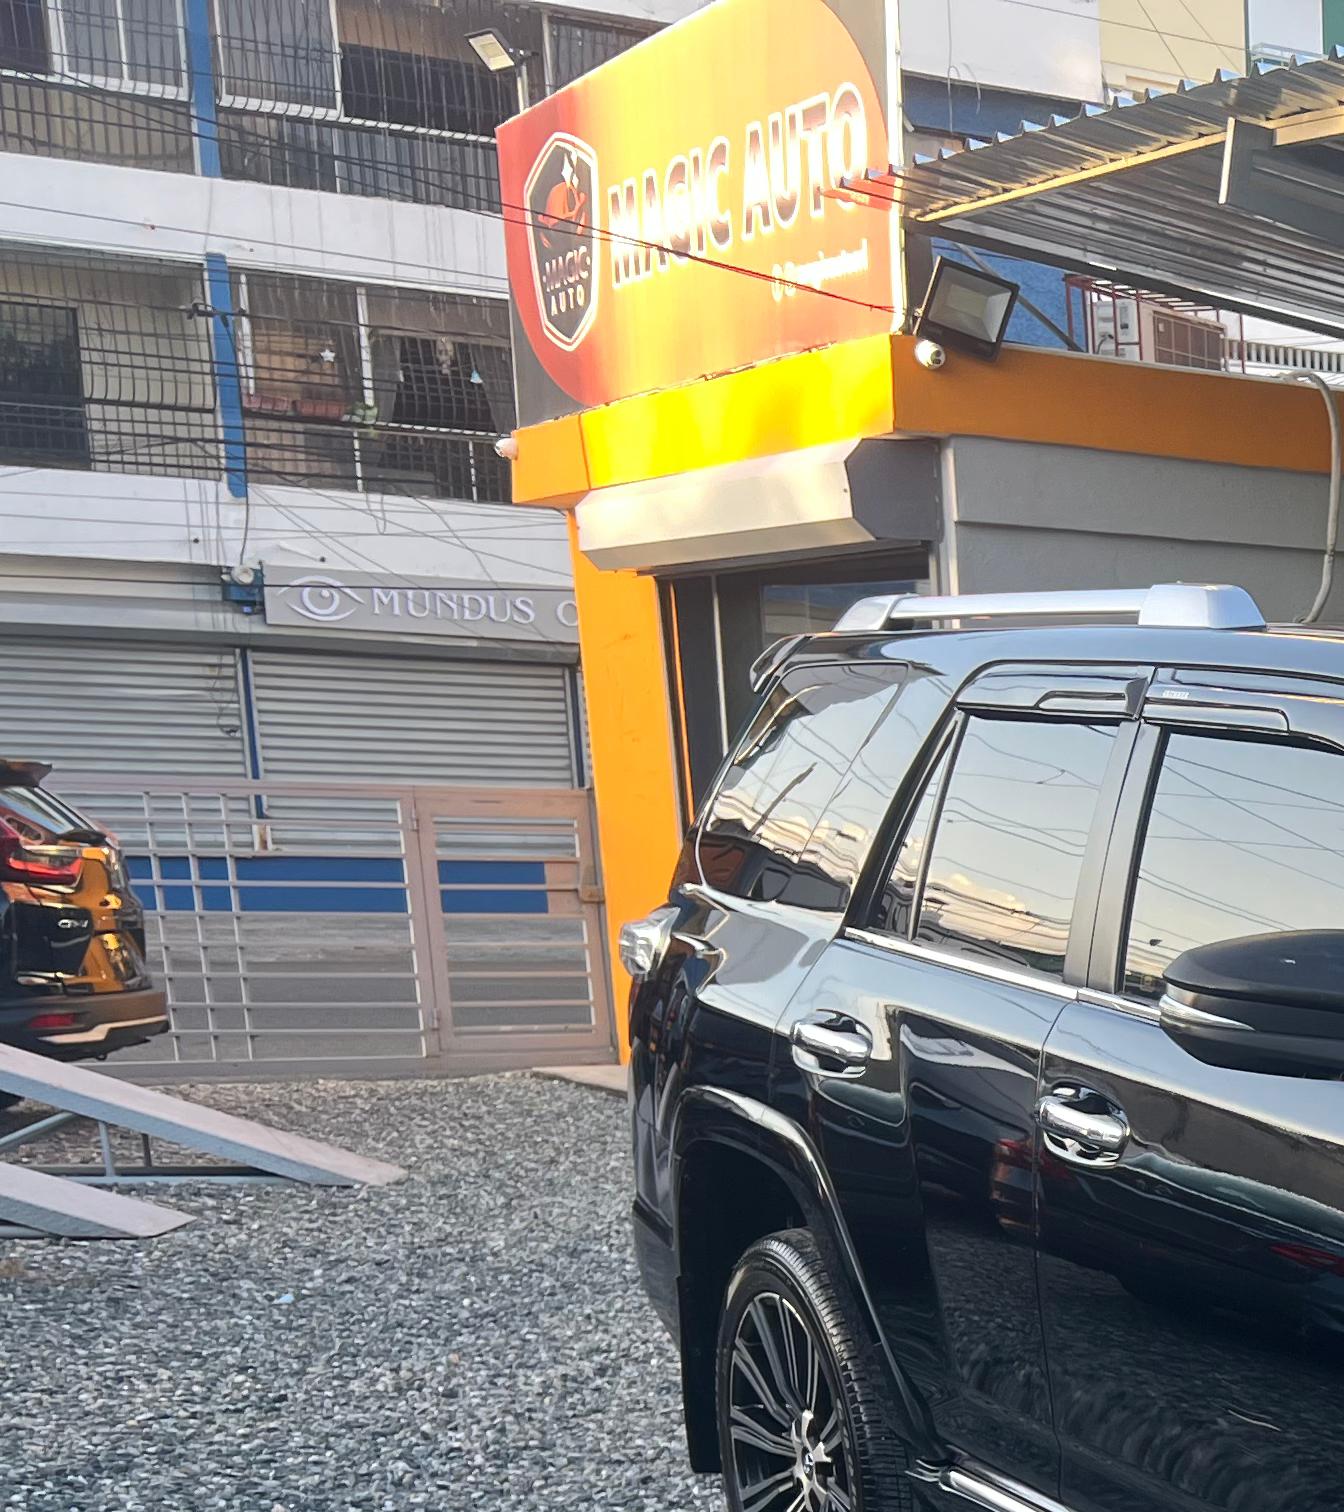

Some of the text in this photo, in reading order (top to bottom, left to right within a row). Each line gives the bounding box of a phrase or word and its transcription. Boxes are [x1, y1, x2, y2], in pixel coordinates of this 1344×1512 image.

[607, 135, 732, 289] MAGIC
[741, 81, 868, 241] AUTO
[551, 284, 585, 317] AUTO
[371, 586, 536, 625] MUNDUS
